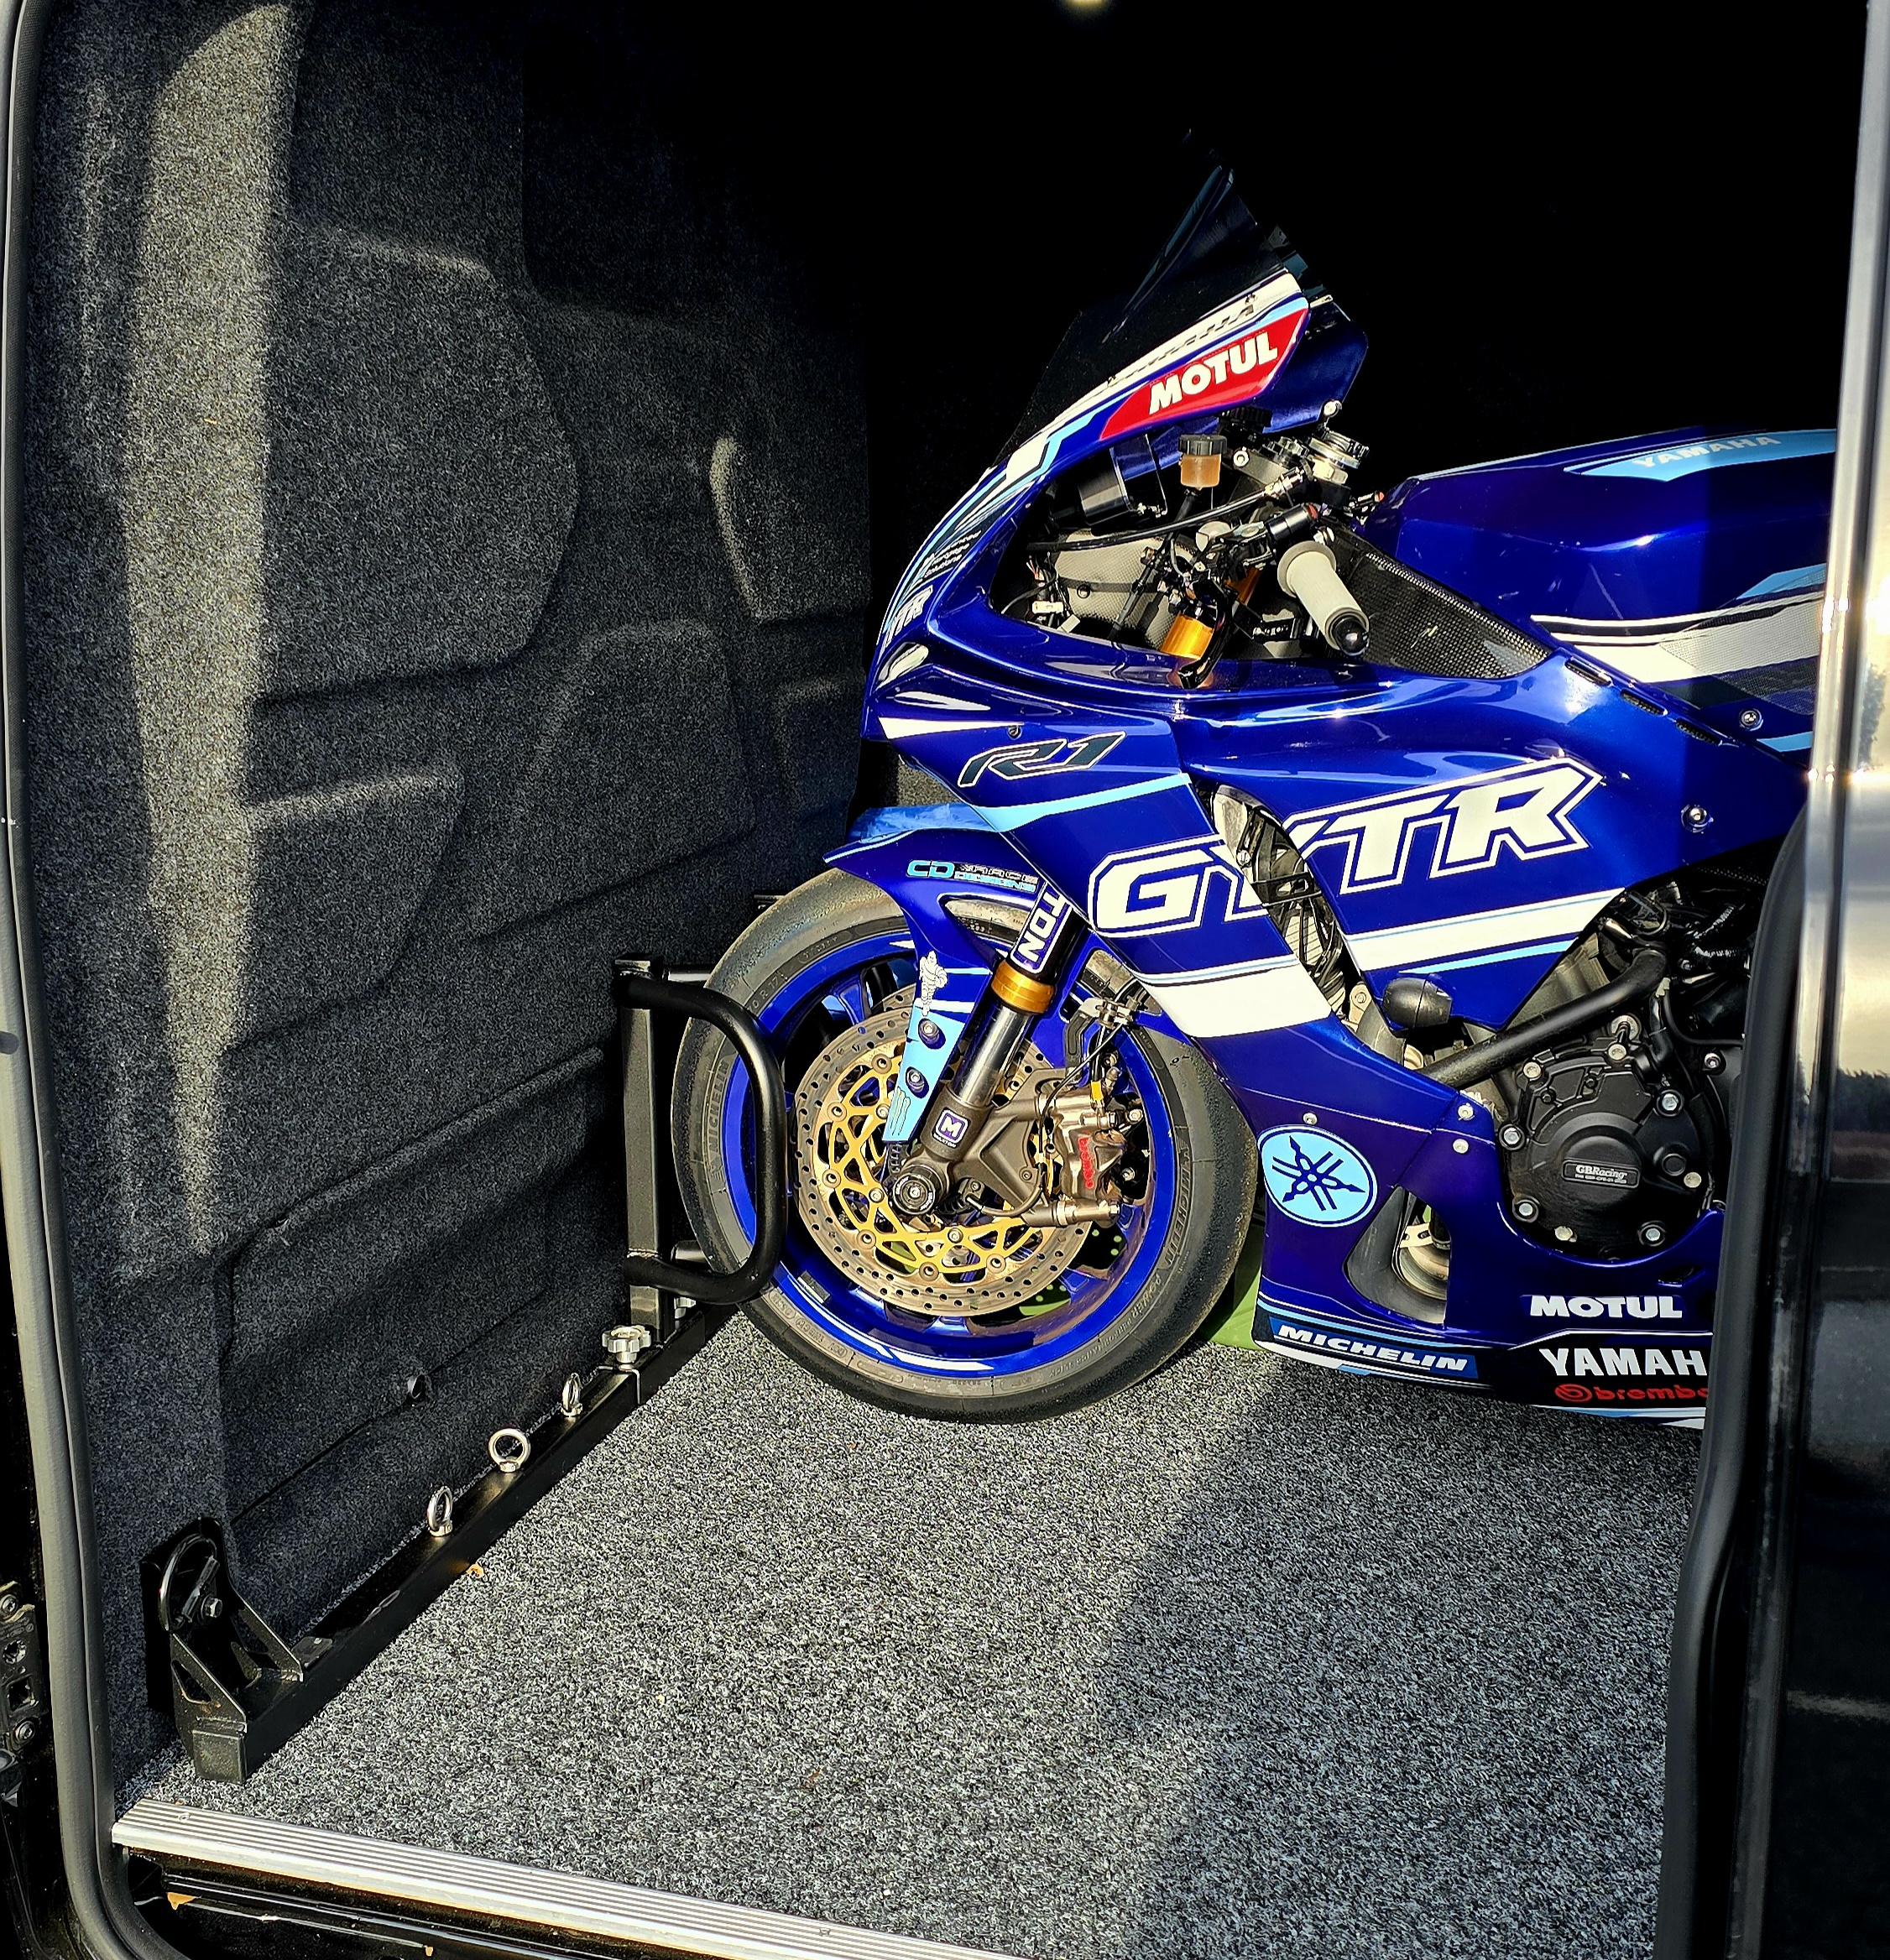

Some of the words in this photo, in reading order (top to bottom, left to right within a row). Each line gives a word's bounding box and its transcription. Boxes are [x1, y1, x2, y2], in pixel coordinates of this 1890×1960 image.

[1149, 331, 1278, 415] MOTUL
[1632, 436, 1781, 467] YAMAHA
[958, 731, 1126, 787] R1
[906, 860, 956, 878] CD
[707, 1058, 730, 1153] MICHELIN
[1575, 1164, 1628, 1181] GBRacing
[1162, 1168, 1190, 1265] MICHELIN
[1128, 1272, 1164, 1319] POWER
[1530, 1295, 1683, 1319] MOTUL
[1277, 1324, 1468, 1371] MICHELIN
[1538, 1348, 1708, 1376] YAMAH
